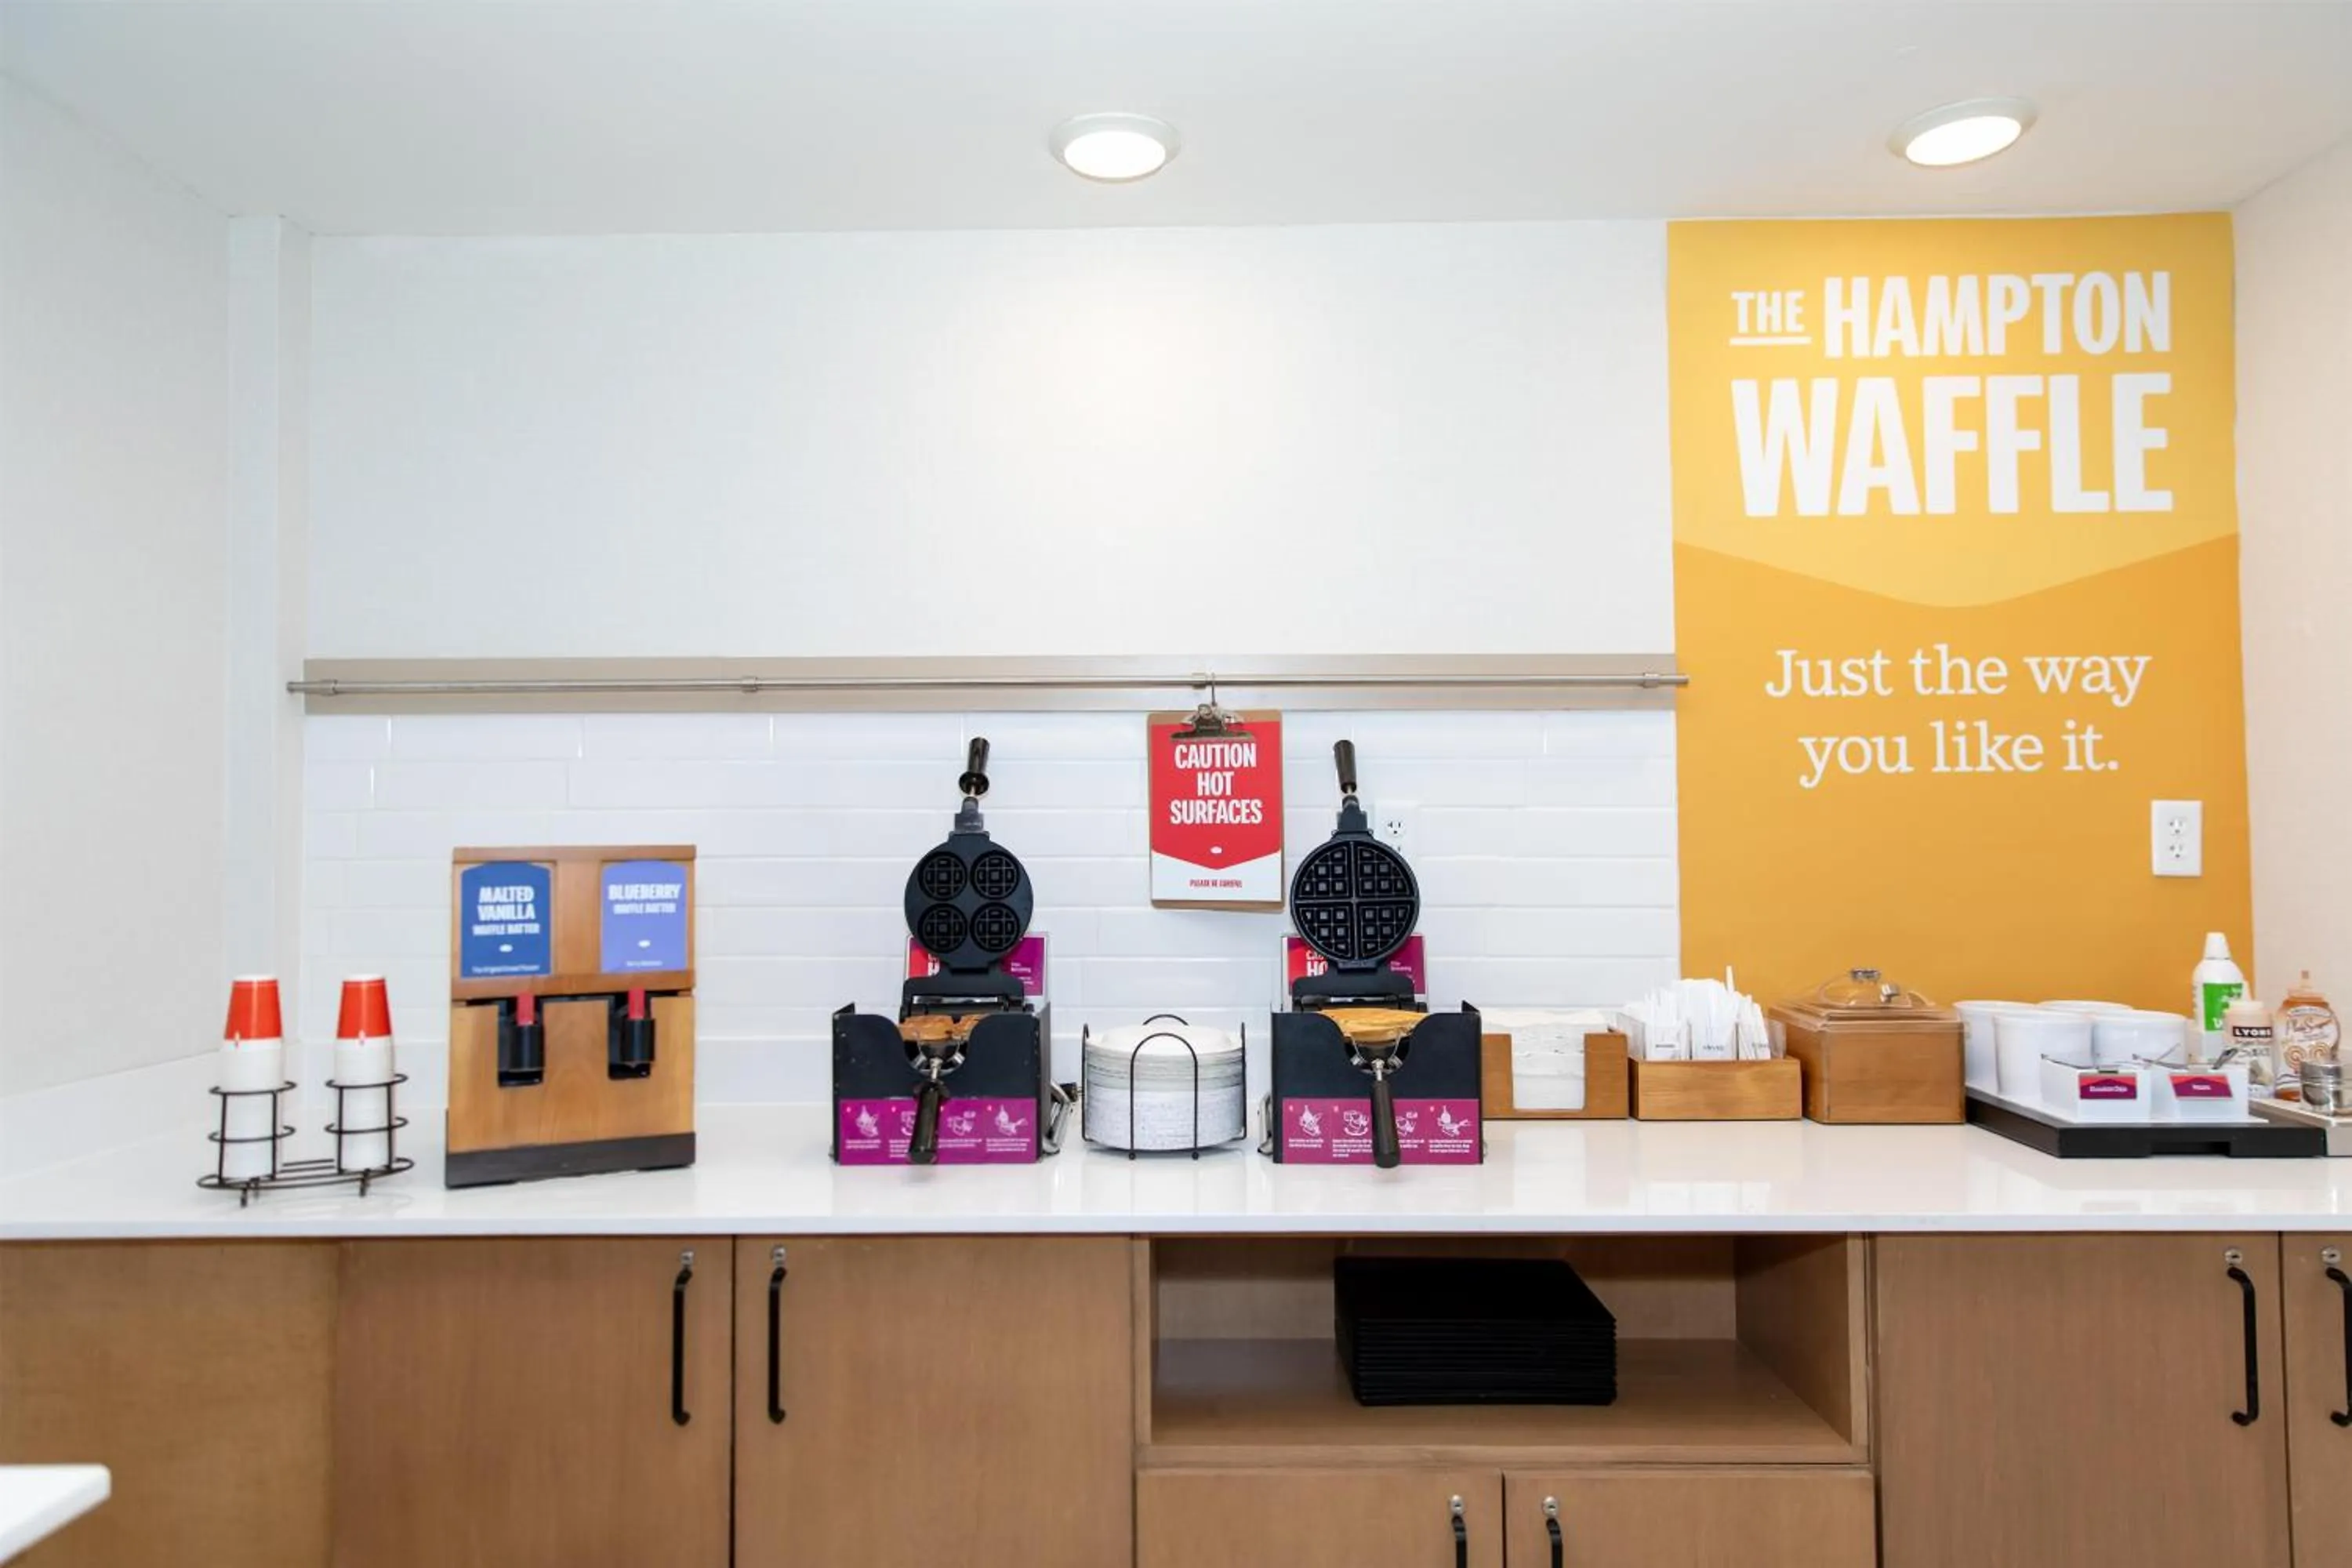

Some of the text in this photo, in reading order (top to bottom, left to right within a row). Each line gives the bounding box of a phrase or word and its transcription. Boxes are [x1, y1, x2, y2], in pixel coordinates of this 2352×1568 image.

[1731, 271, 2170, 358] THE HAMPTON
[1730, 372, 2173, 517] WAFFLE
[1765, 643, 2151, 707] Just the way
[1174, 742, 1257, 769] CAUTION
[1798, 720, 2118, 789] you like it.
[1196, 771, 1235, 797] HOT
[1170, 799, 1263, 825] SURFACES
[478, 886, 535, 903] MALTED
[608, 884, 681, 901] BLUEBERRY
[477, 903, 536, 921] VANILLA
[1307, 960, 1329, 977] HO
